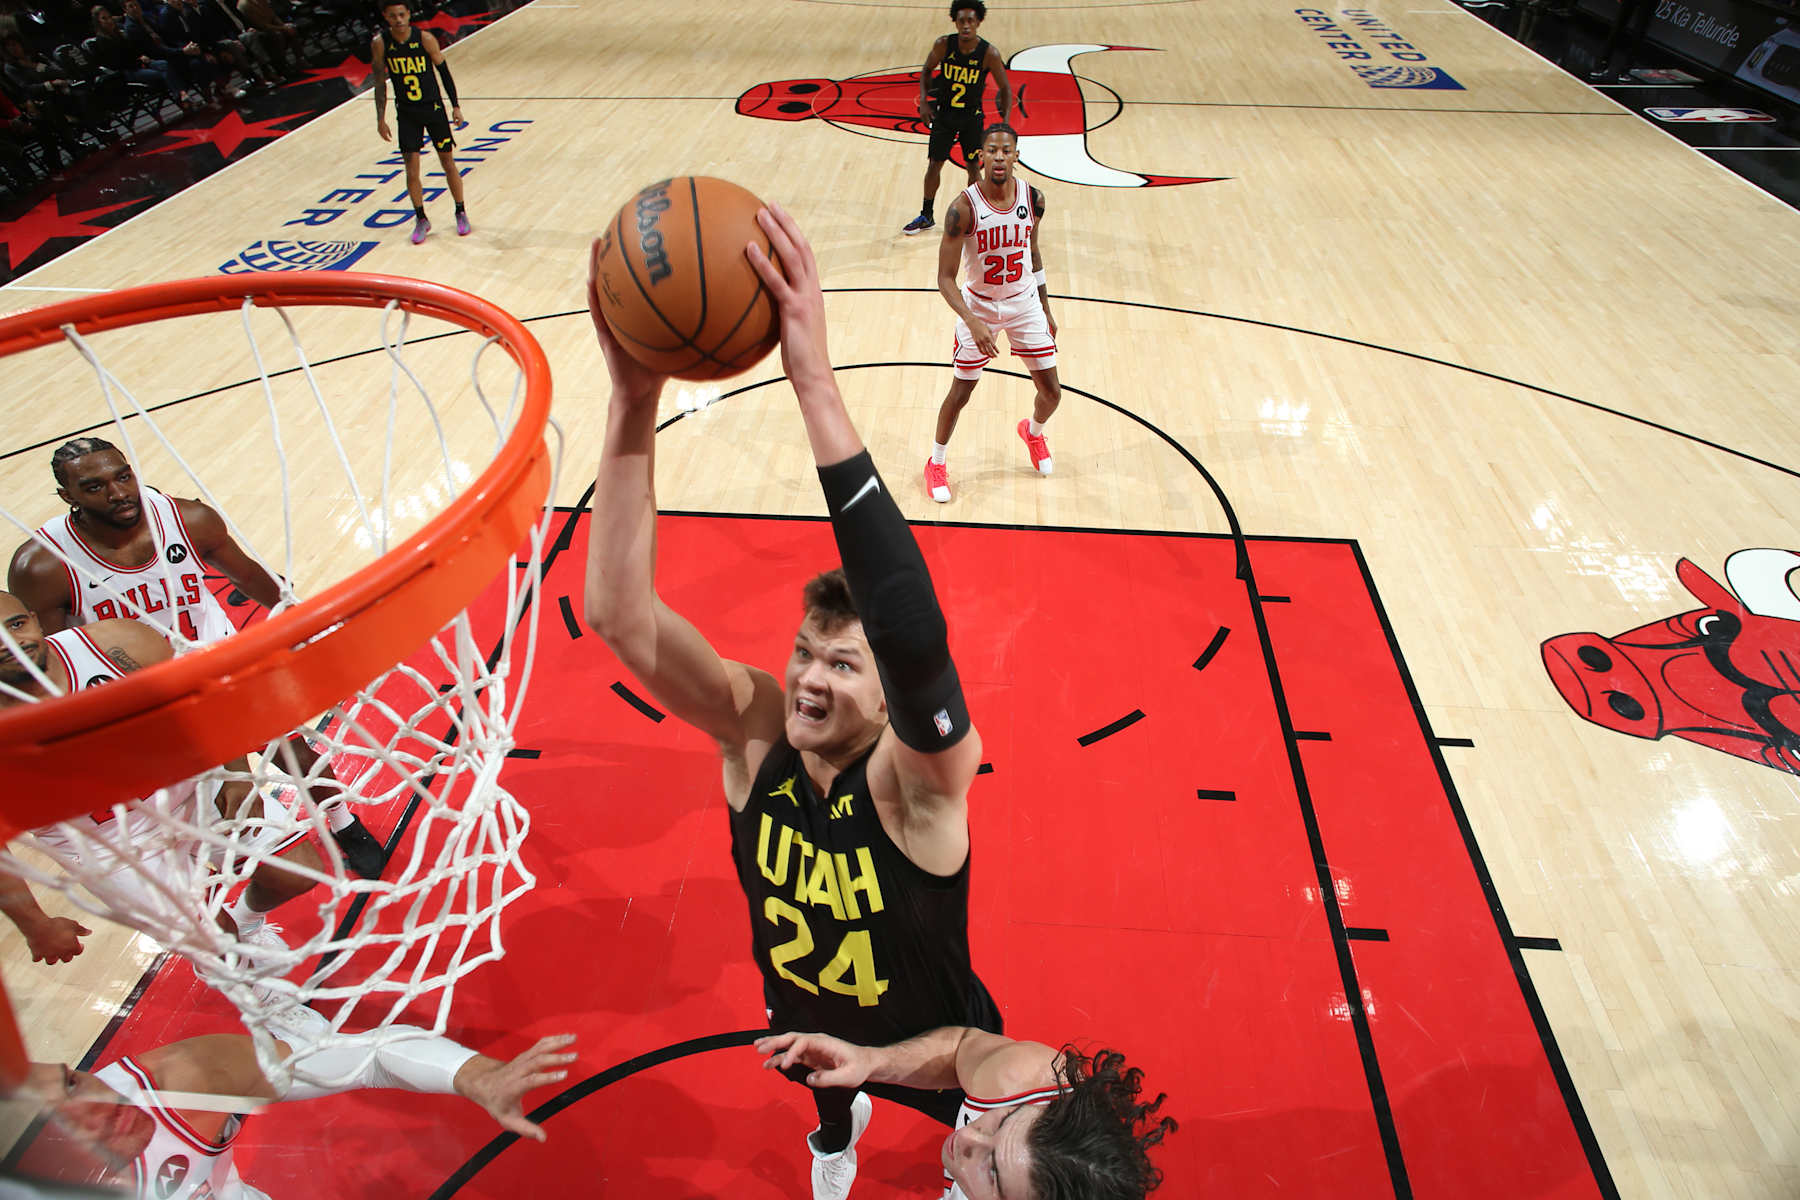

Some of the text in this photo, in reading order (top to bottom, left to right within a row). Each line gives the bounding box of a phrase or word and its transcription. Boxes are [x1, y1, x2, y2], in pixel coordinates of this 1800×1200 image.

[1294, 8, 1372, 60] CENTER
[1341, 9, 1427, 62] UNITED
[1670, 5, 1692, 28] Kia
[387, 56, 426, 74] UTAH
[944, 63, 980, 84] UTAH
[403, 75, 422, 101] 3
[951, 83, 966, 108] 2
[282, 120, 470, 226] NTER
[636, 179, 672, 287] ilson
[984, 250, 1023, 285] 25
[757, 813, 885, 921] UTAH
[764, 896, 889, 1007] 24
